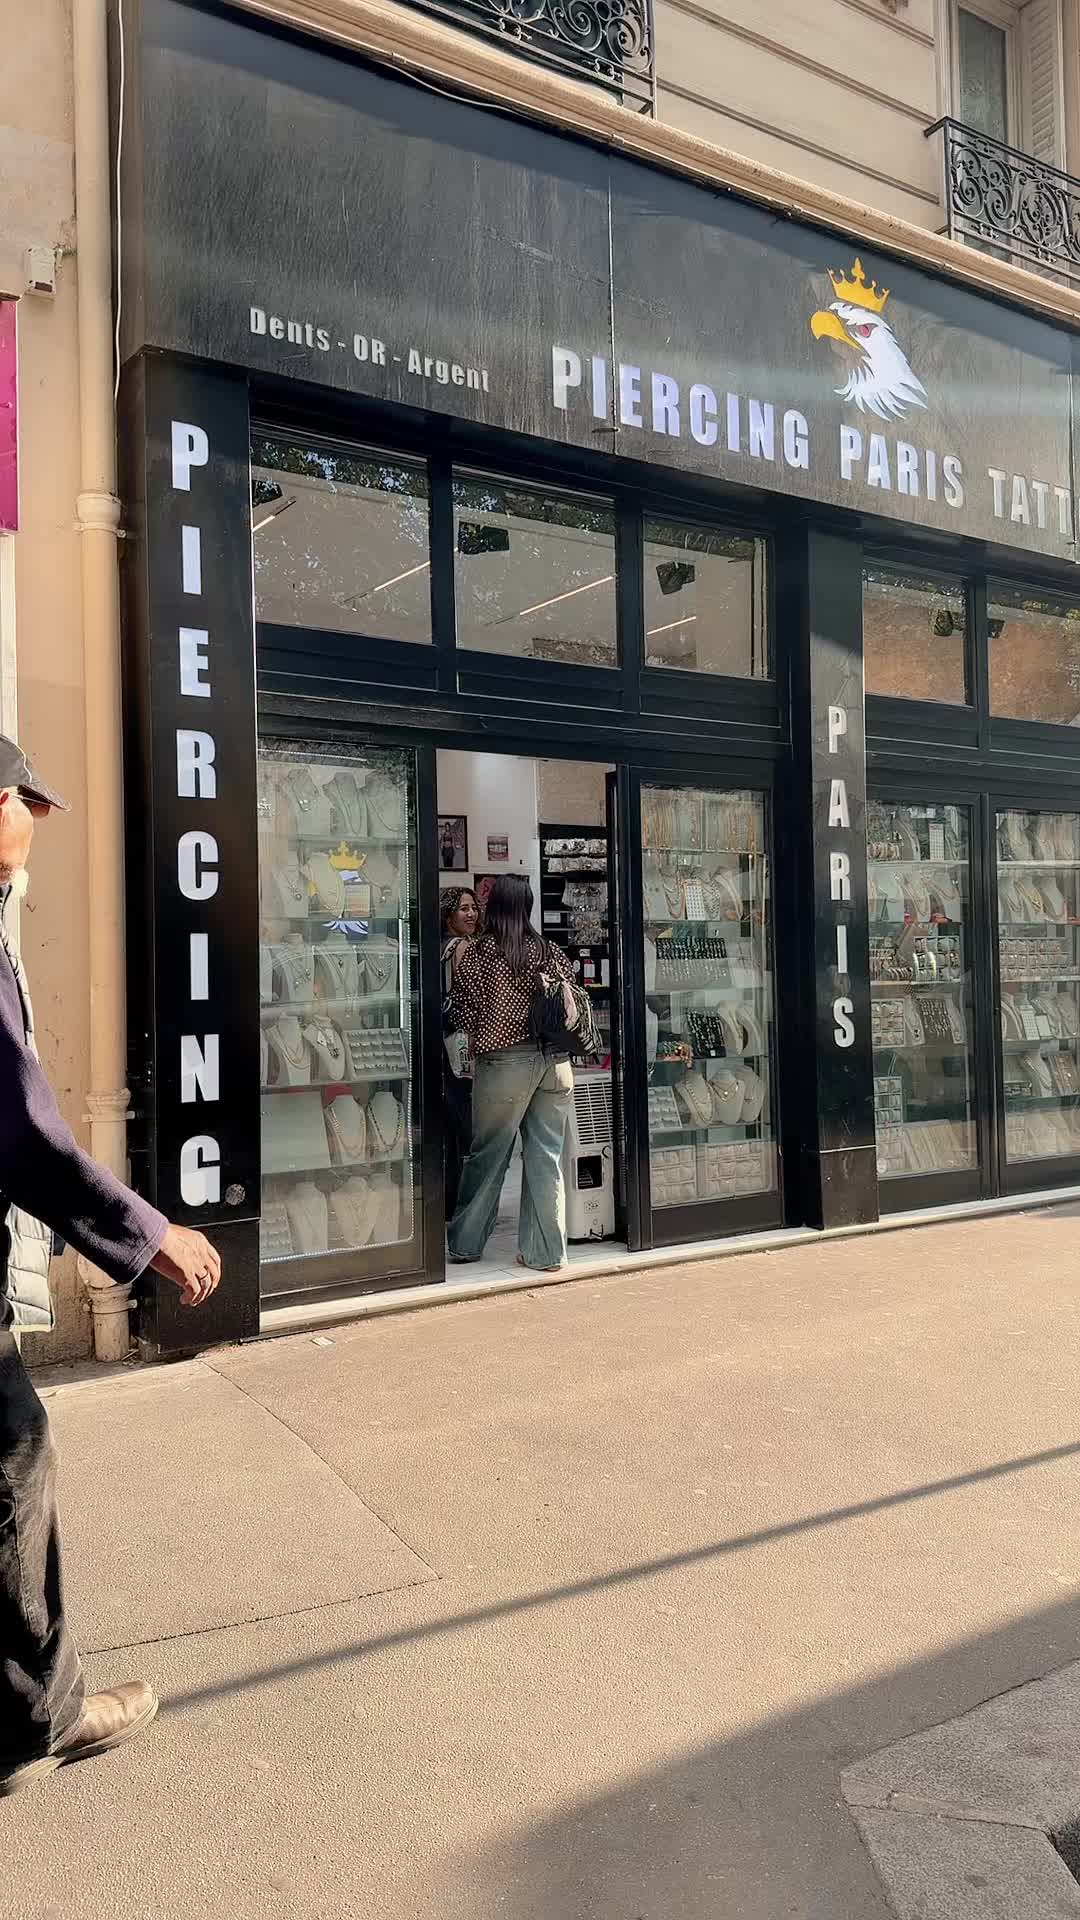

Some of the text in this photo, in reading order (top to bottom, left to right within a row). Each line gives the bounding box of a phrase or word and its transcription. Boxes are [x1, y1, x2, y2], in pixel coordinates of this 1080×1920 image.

[250, 307, 330, 351] Dents
[353, 334, 386, 366] OR
[407, 348, 490, 392] Argent
[551, 345, 1080, 535] PIERCING PARIS TATT
[171, 420, 220, 1206] PIERCING
[828, 705, 855, 1048] PARIS
